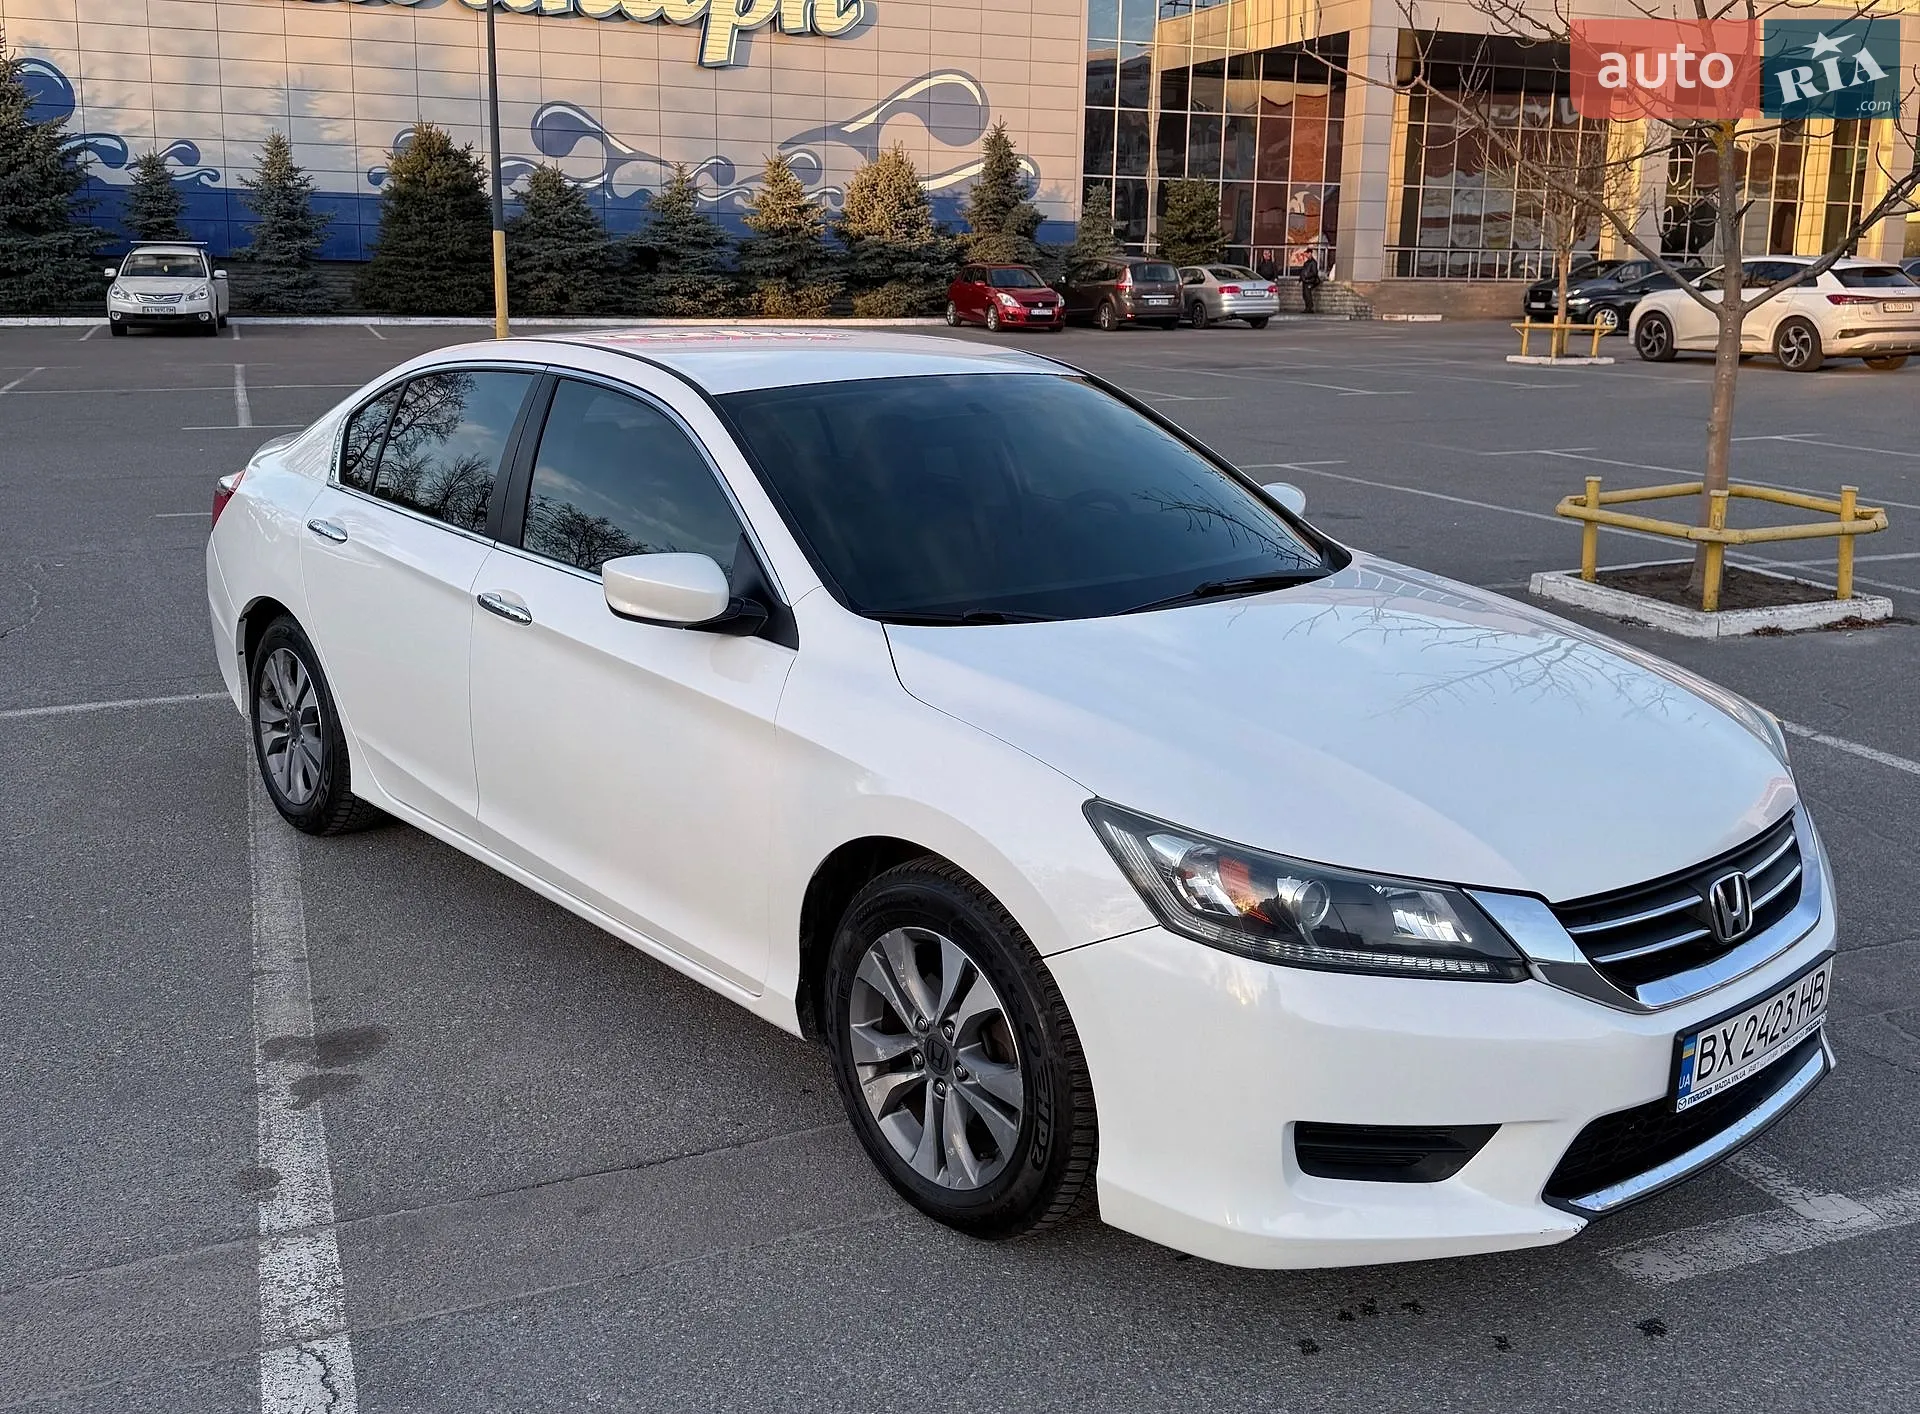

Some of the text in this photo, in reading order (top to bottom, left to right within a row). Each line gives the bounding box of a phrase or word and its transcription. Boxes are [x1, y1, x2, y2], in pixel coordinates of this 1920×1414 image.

[1697, 1022, 1738, 1081] BX
[1741, 989, 1796, 1061] 2423
[1797, 970, 1825, 1025] HB
[1679, 1074, 1690, 1090] UA
[1687, 1087, 1712, 1104] mazda
